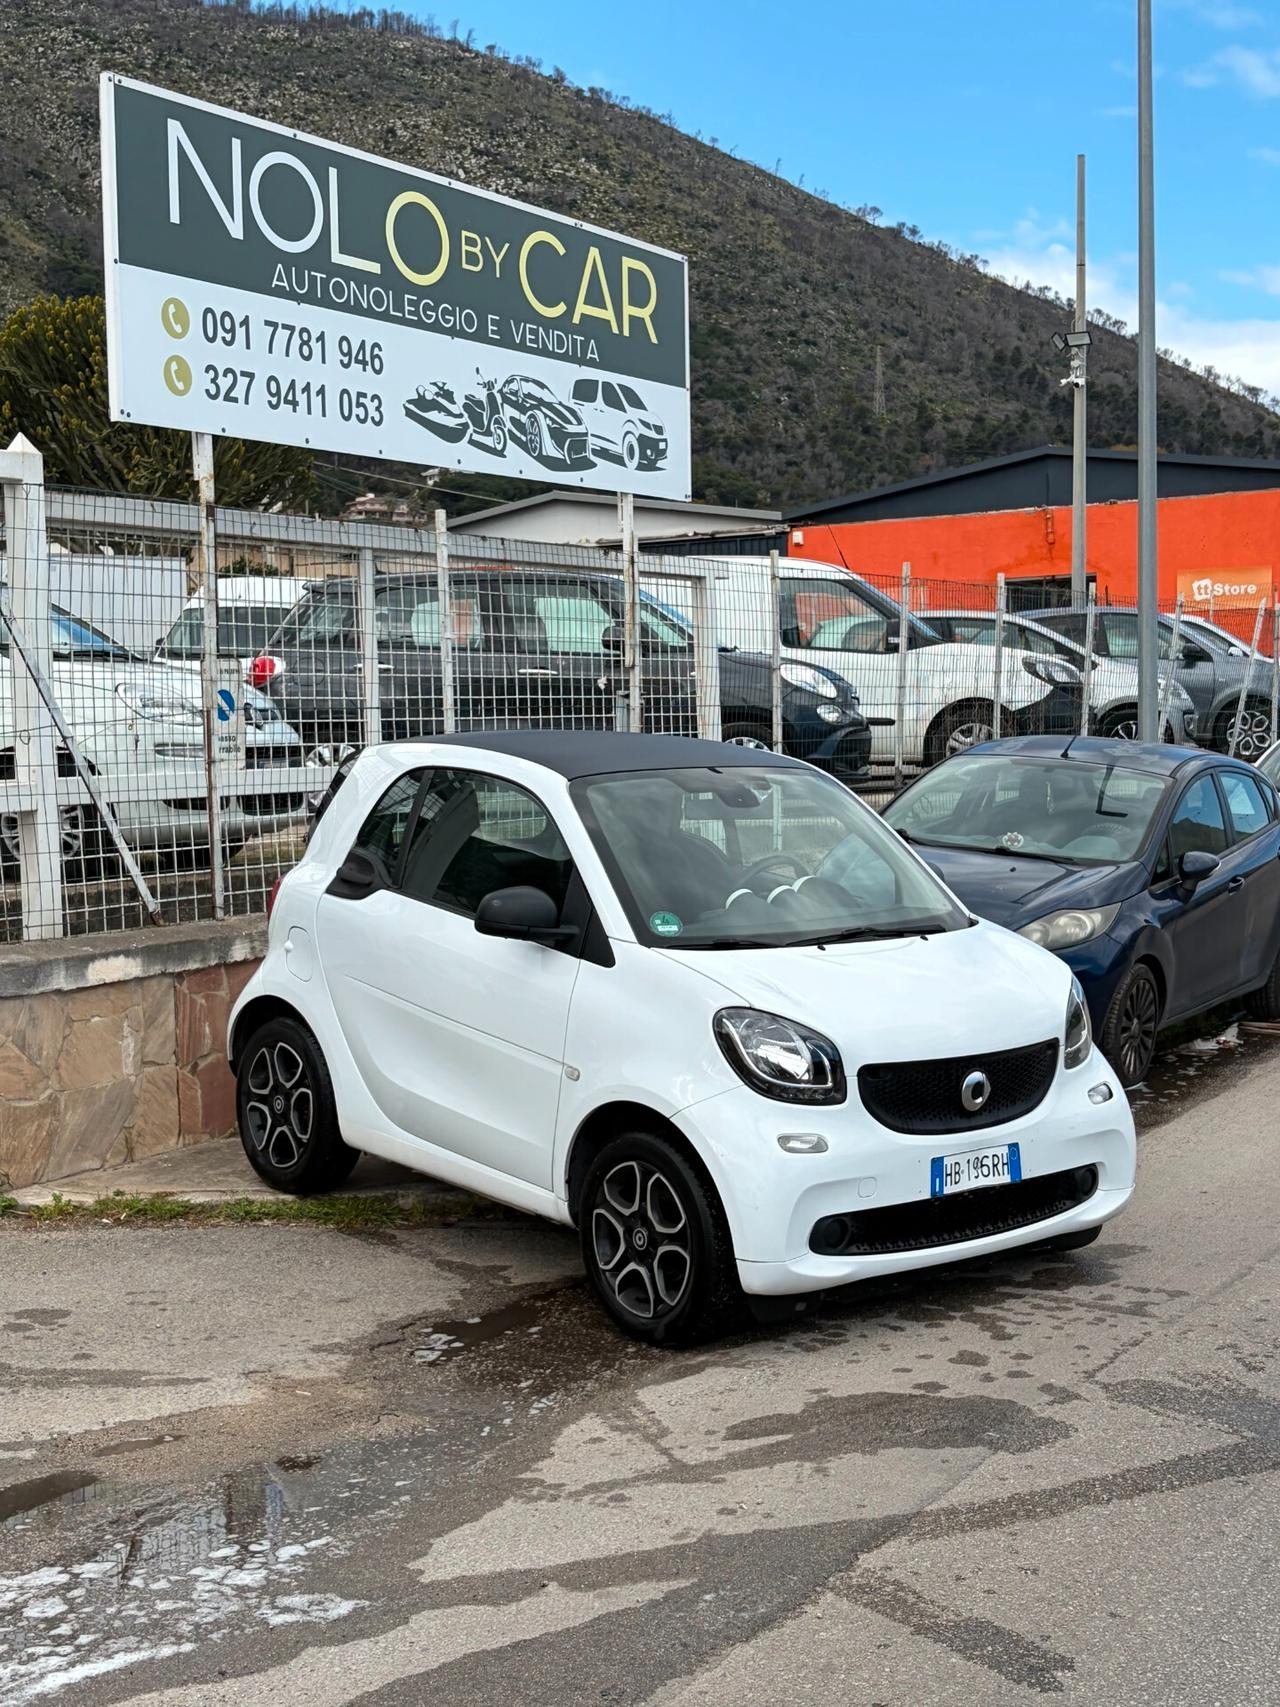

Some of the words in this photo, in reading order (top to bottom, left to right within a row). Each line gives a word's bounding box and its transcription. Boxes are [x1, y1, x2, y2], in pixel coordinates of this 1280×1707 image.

[167, 118, 450, 286] NOLO
[461, 229, 510, 278] BY
[519, 230, 659, 344] CAR
[202, 306, 251, 350] 091
[264, 319, 327, 365] 7781
[338, 335, 384, 375] 946
[271, 263, 478, 333] AUTONOLEGGIO
[487, 315, 501, 339] E
[510, 319, 600, 362] VENDITA
[204, 364, 256, 405] 327
[266, 375, 327, 418] 9411
[339, 388, 384, 427] 053
